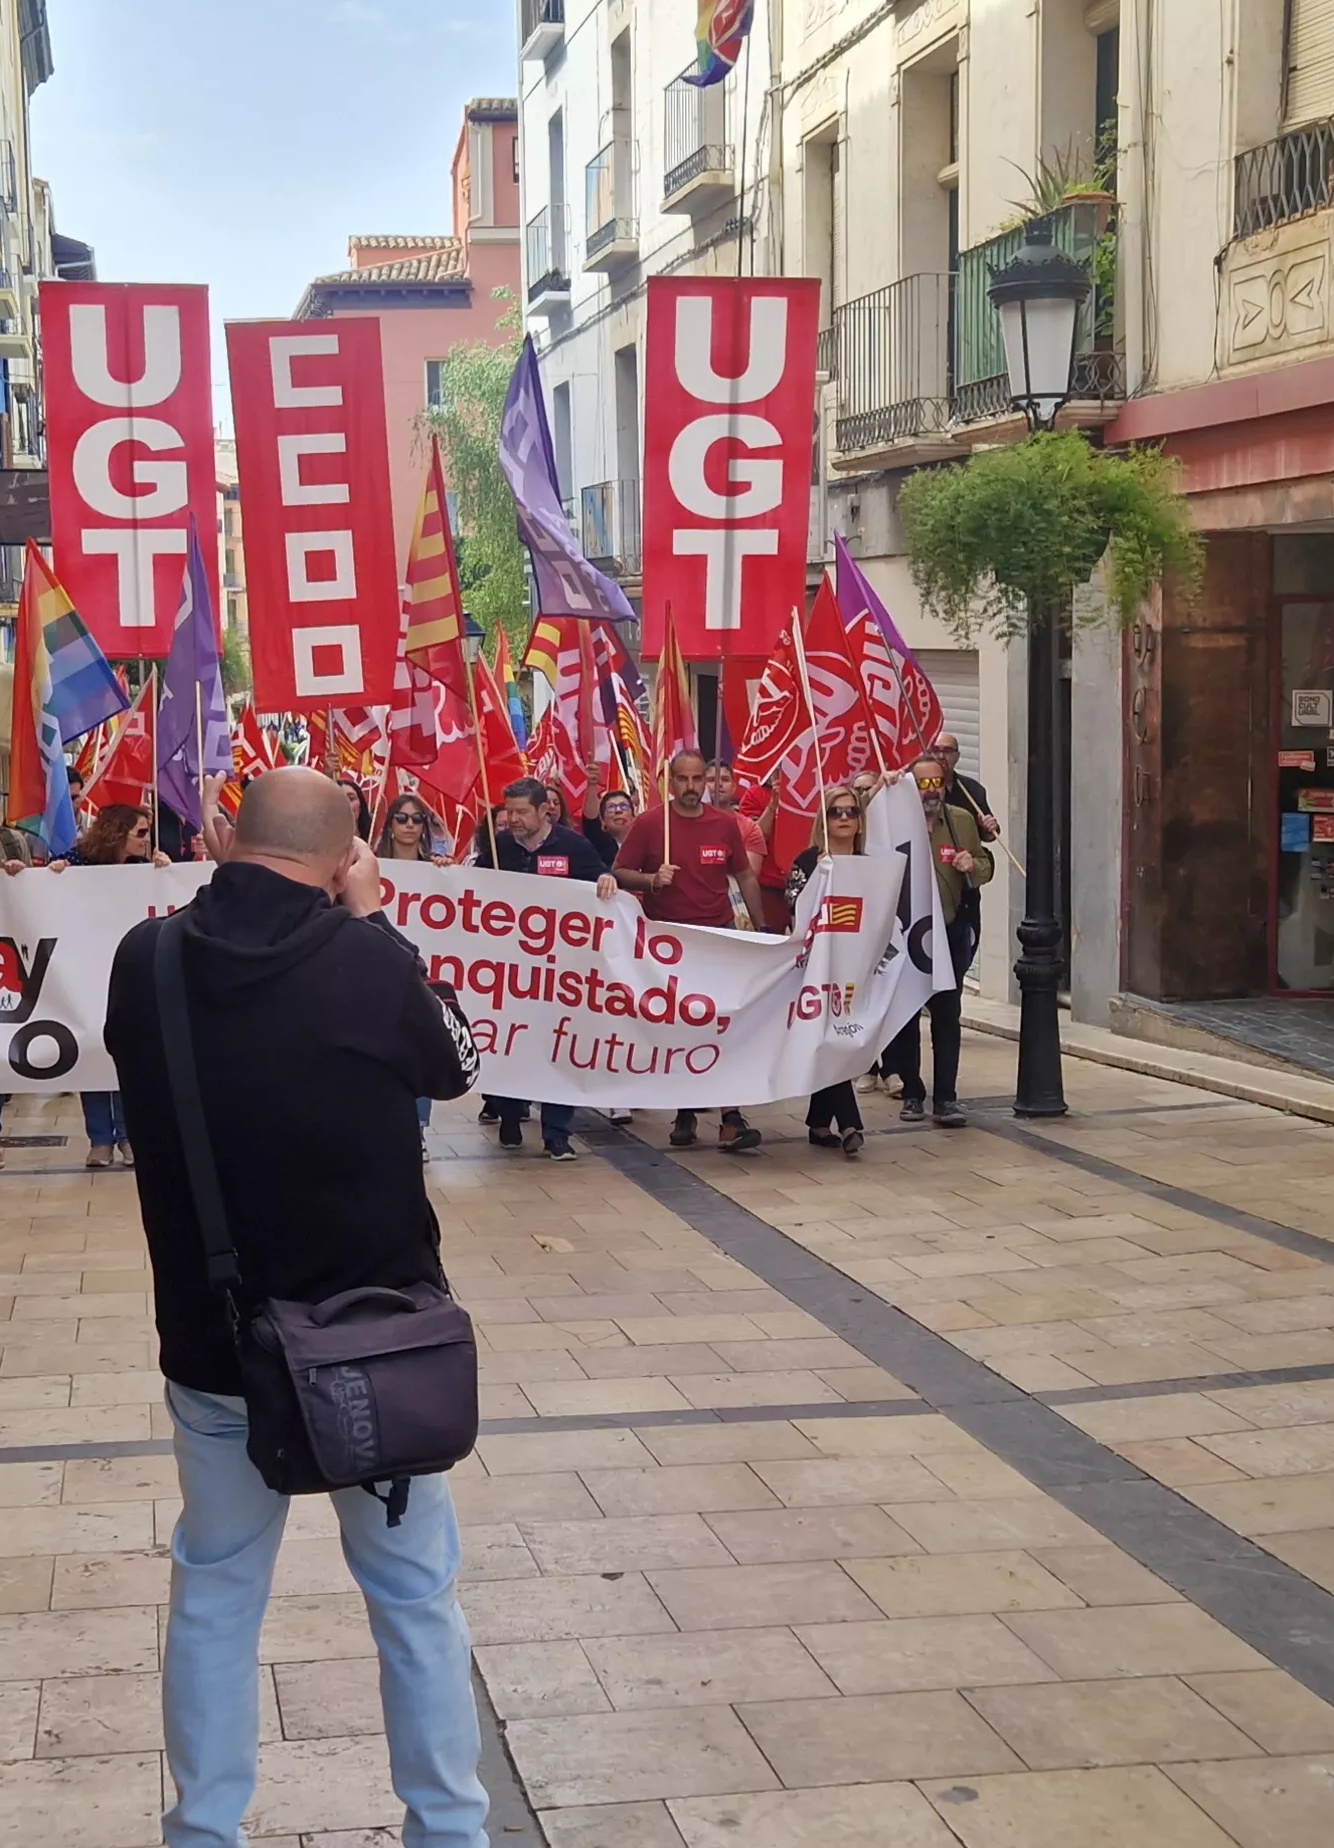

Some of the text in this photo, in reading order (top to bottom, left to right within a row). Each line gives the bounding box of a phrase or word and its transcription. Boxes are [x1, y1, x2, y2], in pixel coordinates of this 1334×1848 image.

[69, 303, 189, 627] UGT
[269, 334, 365, 697] CCOO
[668, 296, 788, 630] UGT
[430, 954, 732, 1035] nquistado,
[634, 915, 684, 966] lo
[550, 1015, 722, 1076] futuro
